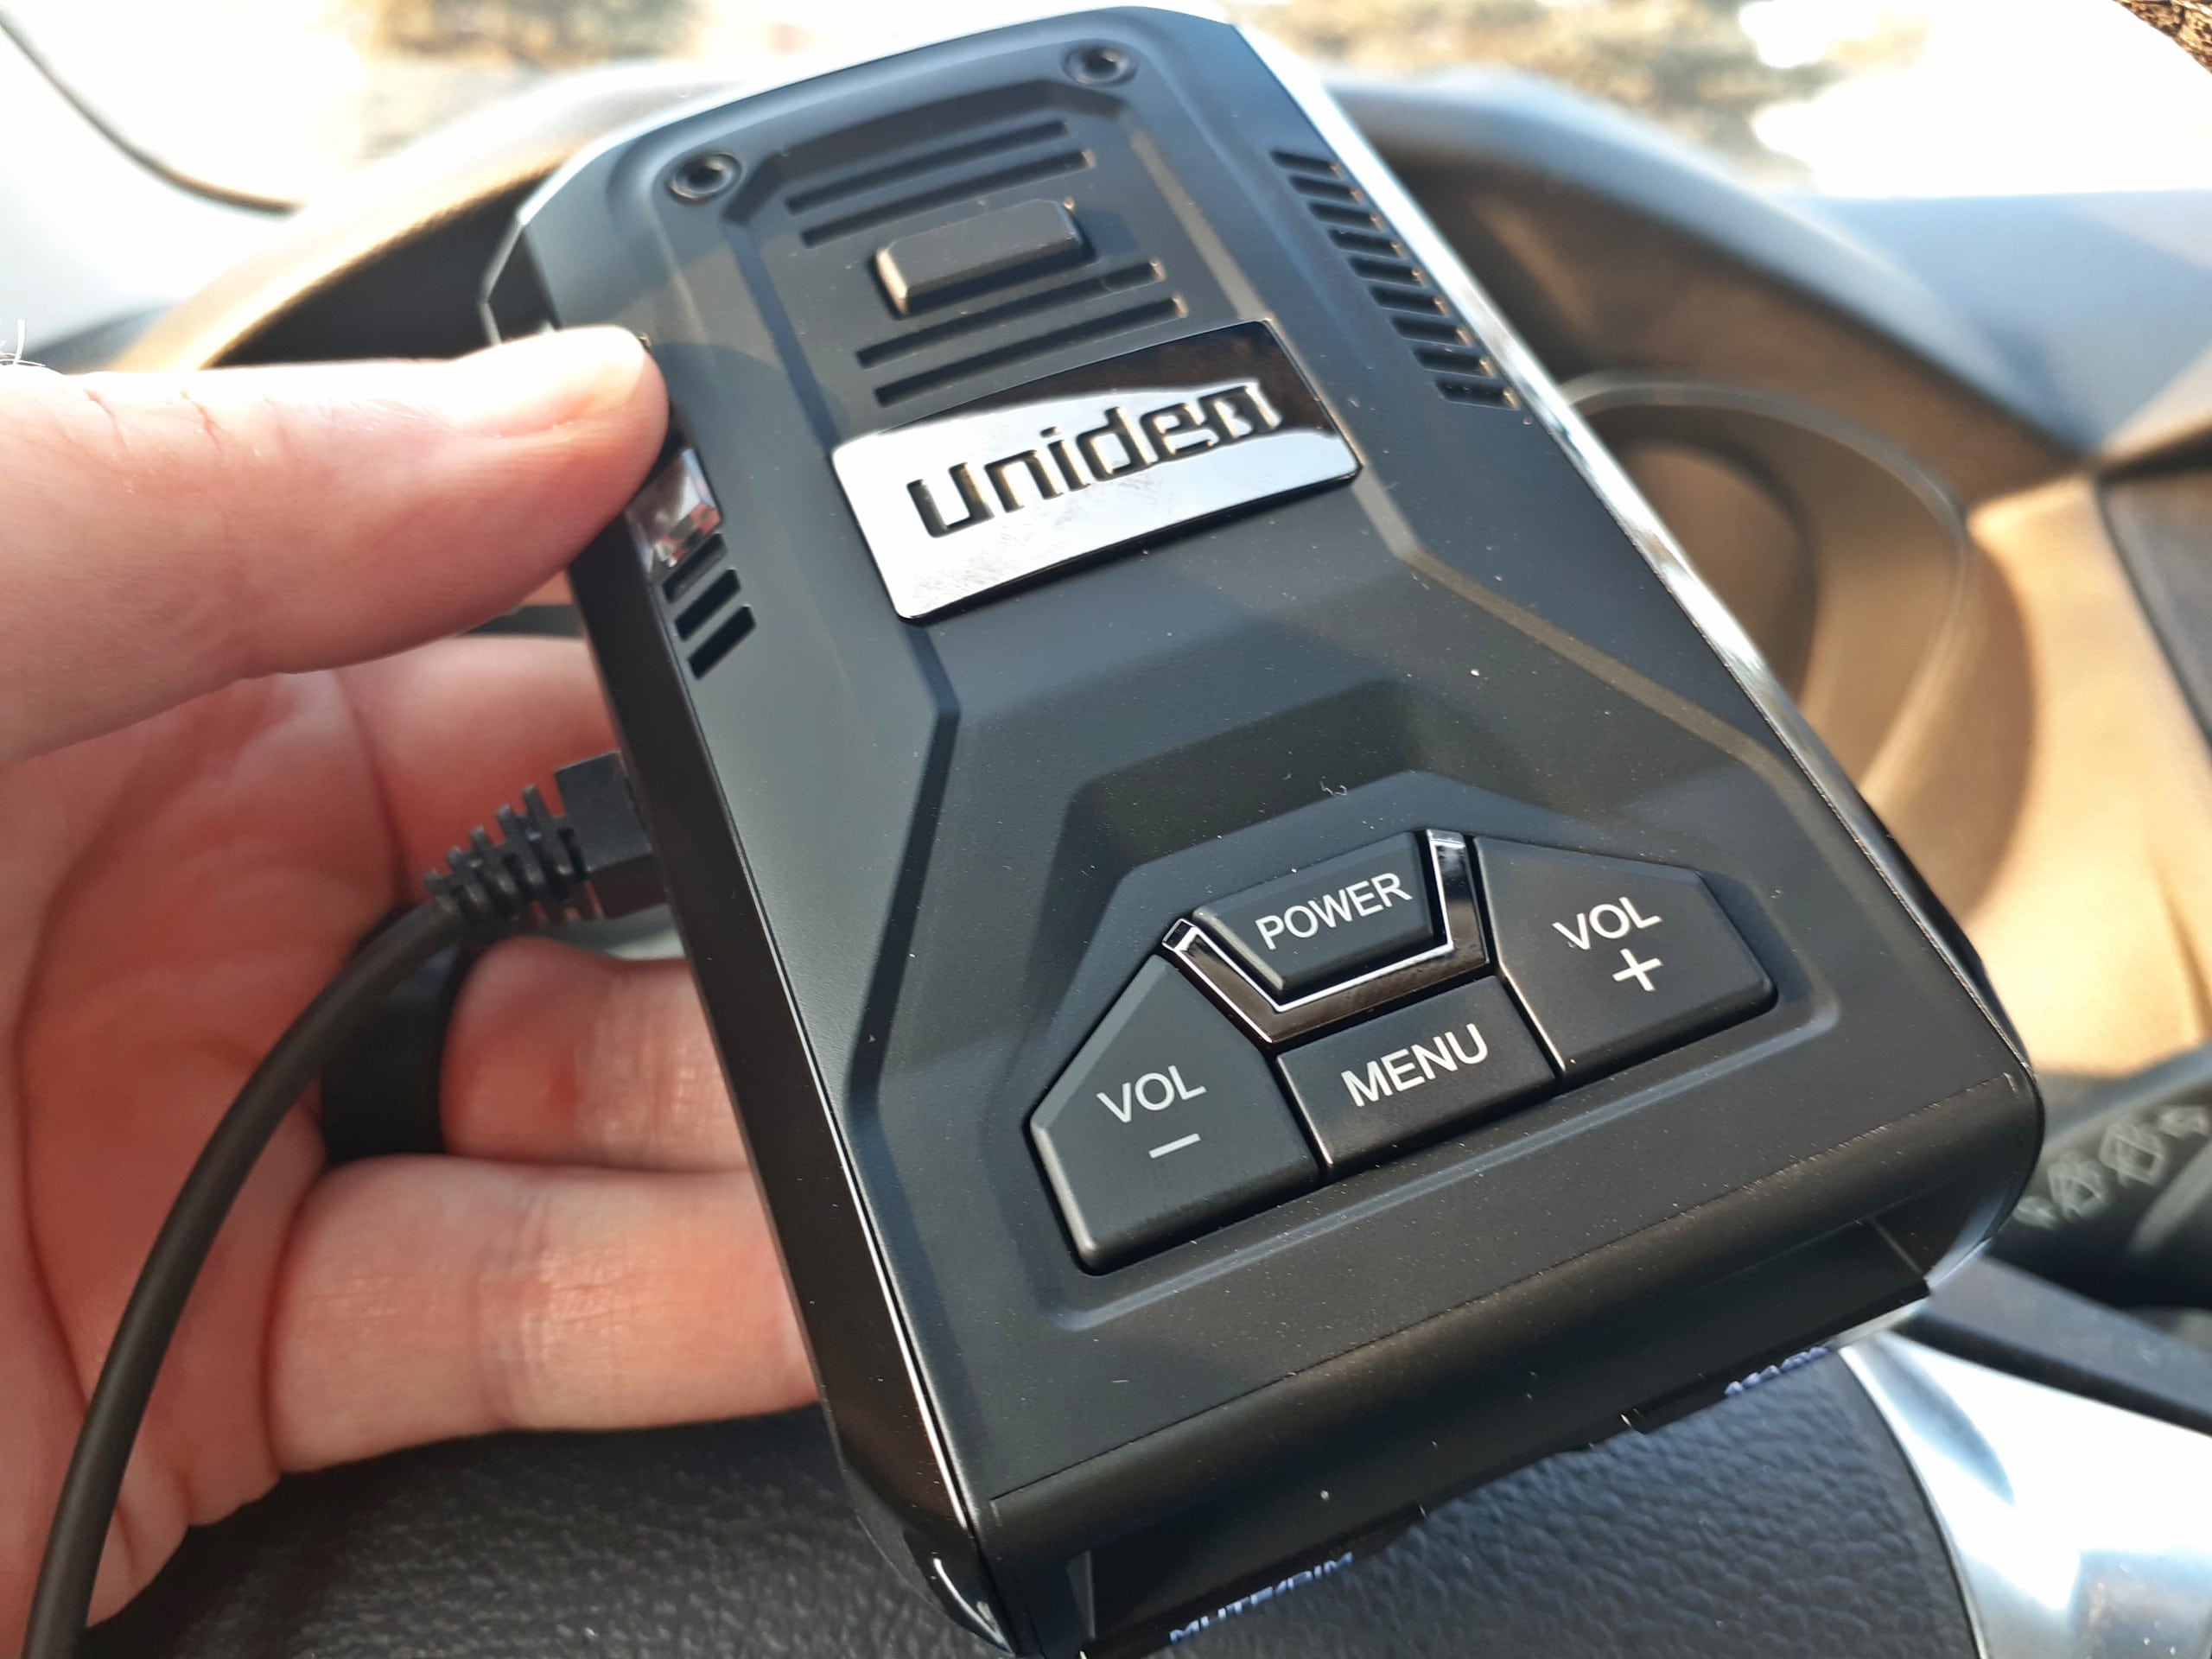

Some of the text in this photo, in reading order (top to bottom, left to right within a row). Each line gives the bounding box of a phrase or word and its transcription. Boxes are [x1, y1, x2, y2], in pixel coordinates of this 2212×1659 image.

[906, 383, 1282, 538] Uniden
[1255, 872, 1414, 950] POWER
[1551, 896, 1662, 951] VOL
[1096, 1065, 1207, 1123] VOL
[1340, 1022, 1489, 1108] MENU
